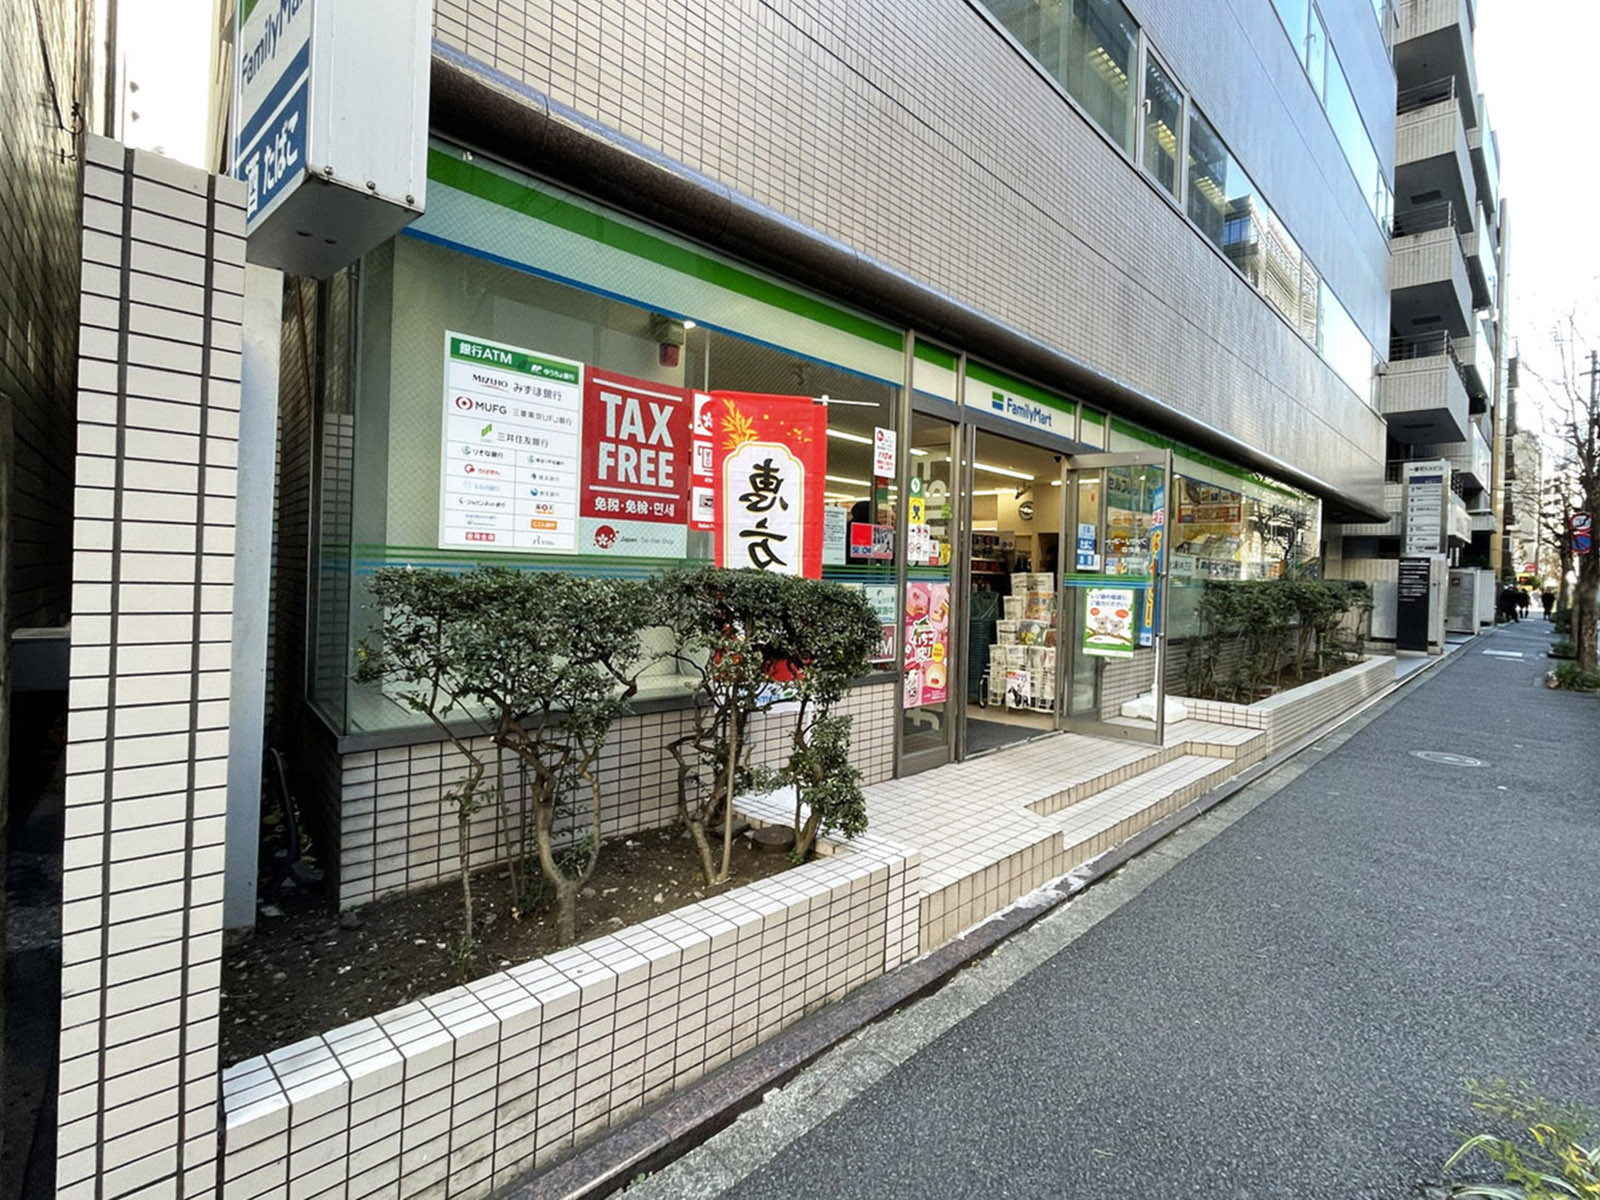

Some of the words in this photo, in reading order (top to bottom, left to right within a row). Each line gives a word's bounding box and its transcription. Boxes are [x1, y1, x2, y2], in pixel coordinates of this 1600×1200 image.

[242, 0, 304, 85] FamilyMa
[263, 111, 299, 196] たばこ
[459, 342, 513, 365] 銀行ATM
[512, 382, 563, 402] みずほ銀行
[475, 401, 507, 415] MUFG
[600, 390, 674, 448] TAX
[1006, 397, 1052, 427] FamilyMart
[497, 431, 549, 449] 三井住友銀行
[598, 441, 674, 488] FREE
